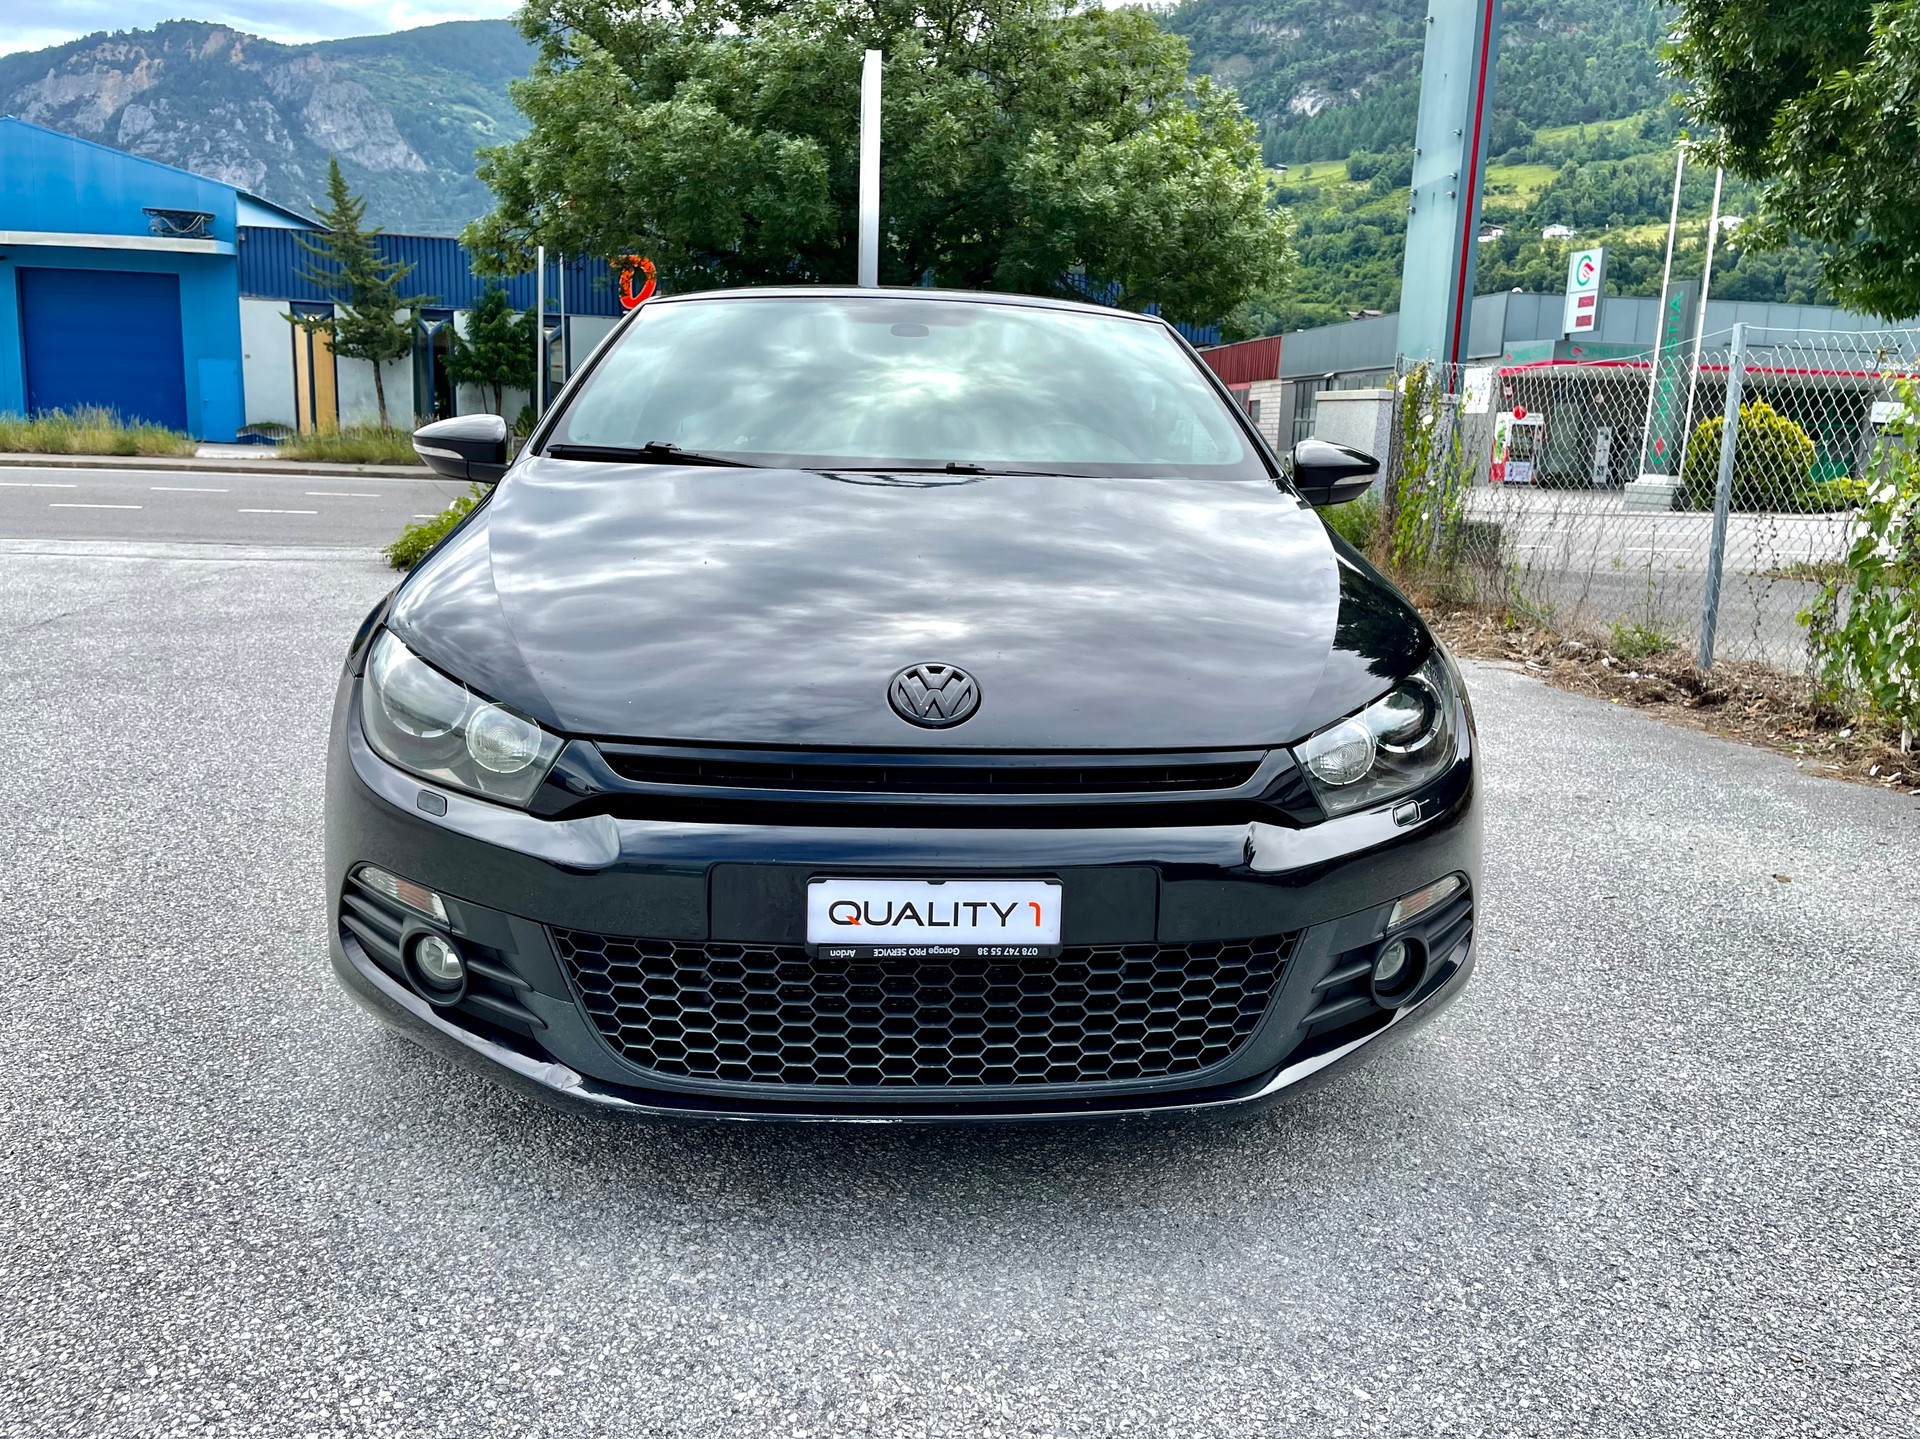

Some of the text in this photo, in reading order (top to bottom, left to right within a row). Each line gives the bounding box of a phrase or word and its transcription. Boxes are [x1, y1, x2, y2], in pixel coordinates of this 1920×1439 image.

[828, 900, 1042, 927] QUALITY 1
[829, 945, 1038, 958] 078 747 55 38 Garage PRO SERVICE Ardon
